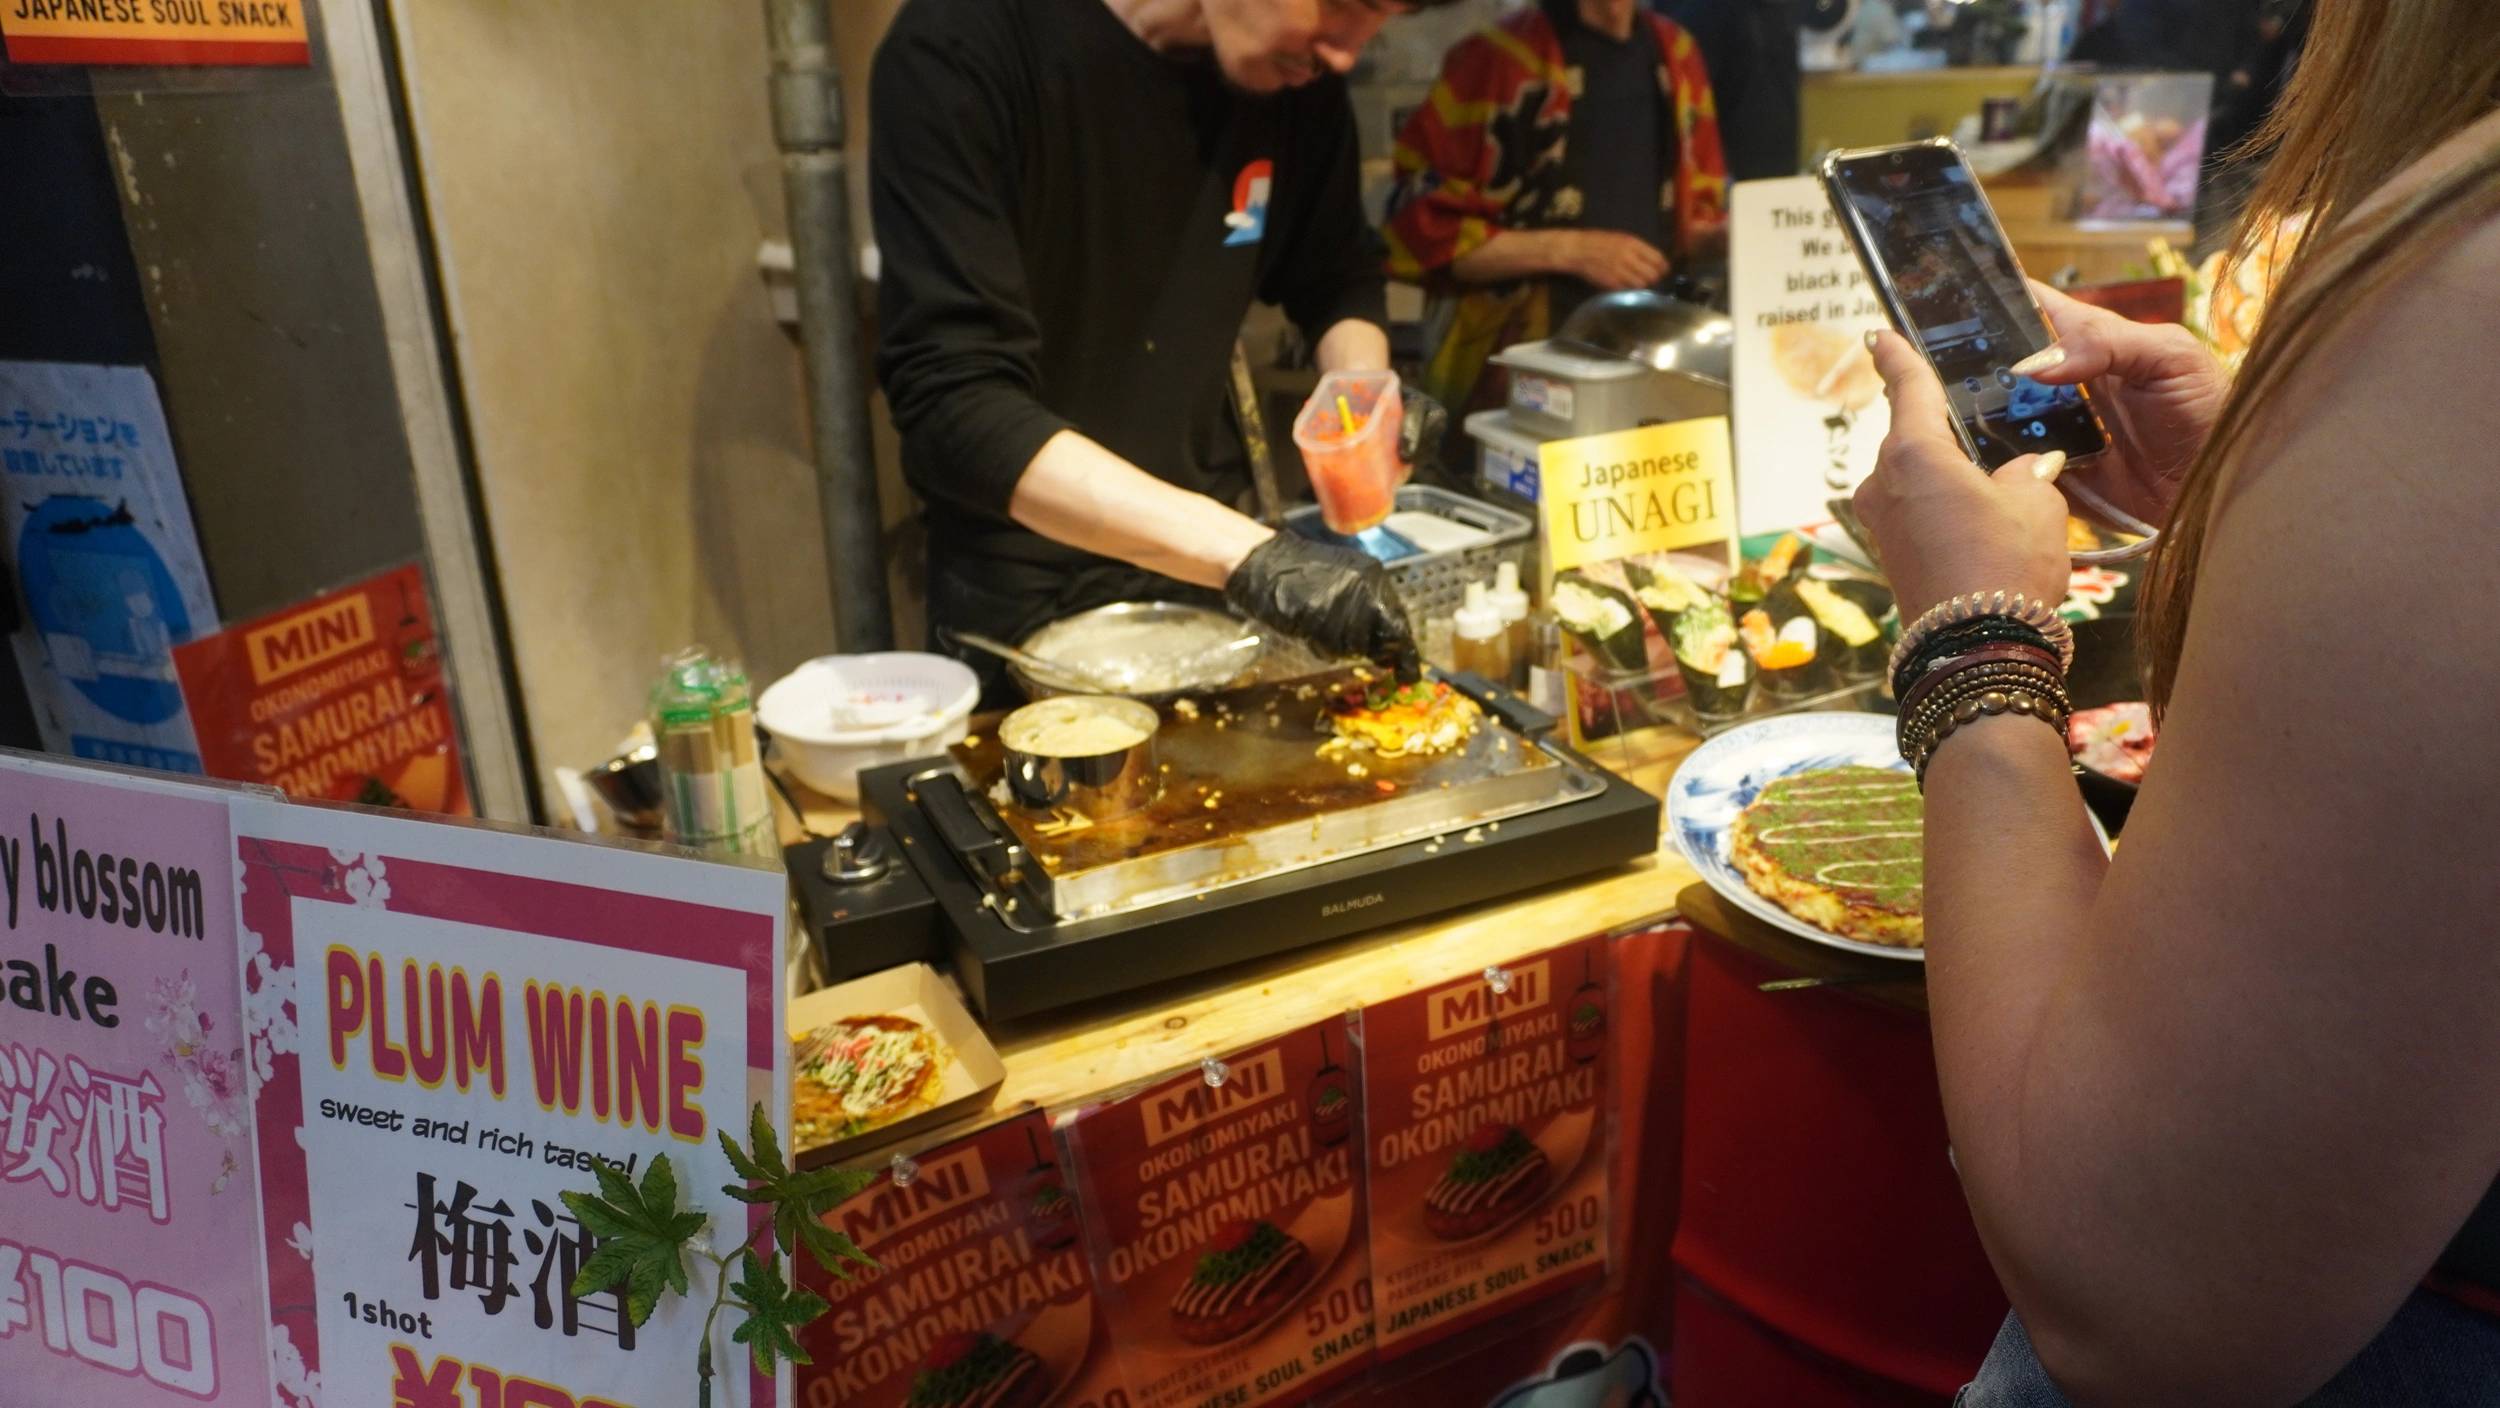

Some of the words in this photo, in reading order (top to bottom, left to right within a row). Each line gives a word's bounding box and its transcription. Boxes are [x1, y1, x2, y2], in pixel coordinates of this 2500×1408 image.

[15, 0, 144, 24] JAPANESE
[152, 0, 210, 26] SOUL
[219, 2, 292, 28] SNACK
[1771, 208, 1815, 229] This
[1802, 239, 1833, 257] We
[1757, 303, 1821, 327] raised
[1828, 301, 1846, 319] in
[1786, 270, 1841, 293] black
[1579, 451, 1699, 488] Japanese
[1569, 478, 1717, 543] UNAGI
[262, 606, 361, 672] MINI
[250, 650, 388, 722] OKONOMIYAKI
[253, 677, 407, 775] SAMURAI
[31, 812, 204, 941] blossom
[1322, 893, 1384, 917] BALMUDA
[0, 943, 120, 1029] ake
[1442, 971, 1537, 1030] MINI
[326, 943, 508, 1100] PLUM
[523, 978, 706, 1145] WINE
[1412, 1040, 1565, 1119] SAMURAI
[320, 1098, 404, 1132] sweet
[412, 1120, 469, 1146] and
[478, 1128, 533, 1159] rich
[1157, 1062, 1269, 1133] MINI
[1379, 1067, 1594, 1168] OKONOMIYAKI
[1138, 1126, 1310, 1228] SAMURAI
[1139, 1100, 1298, 1182] OKONOMIYAKI
[844, 1162, 971, 1245] MINI
[1108, 1149, 1348, 1283] OKONOMIYAKI
[1536, 1195, 1598, 1247] 500
[829, 1201, 1009, 1301] OKONOMIYAKI
[1387, 1281, 1478, 1334] JAPANESE
[1485, 1264, 1528, 1295] SOUL
[1536, 1237, 1595, 1274] SNACK
[343, 1292, 433, 1339] 1shot
[833, 1226, 1031, 1353] SAMURAI
[1305, 1278, 1374, 1338] 500
[807, 1251, 1083, 1408] OKONOMIYAKI
[1255, 1358, 1305, 1395] SOUL
[1312, 1322, 1376, 1367] SNACK
